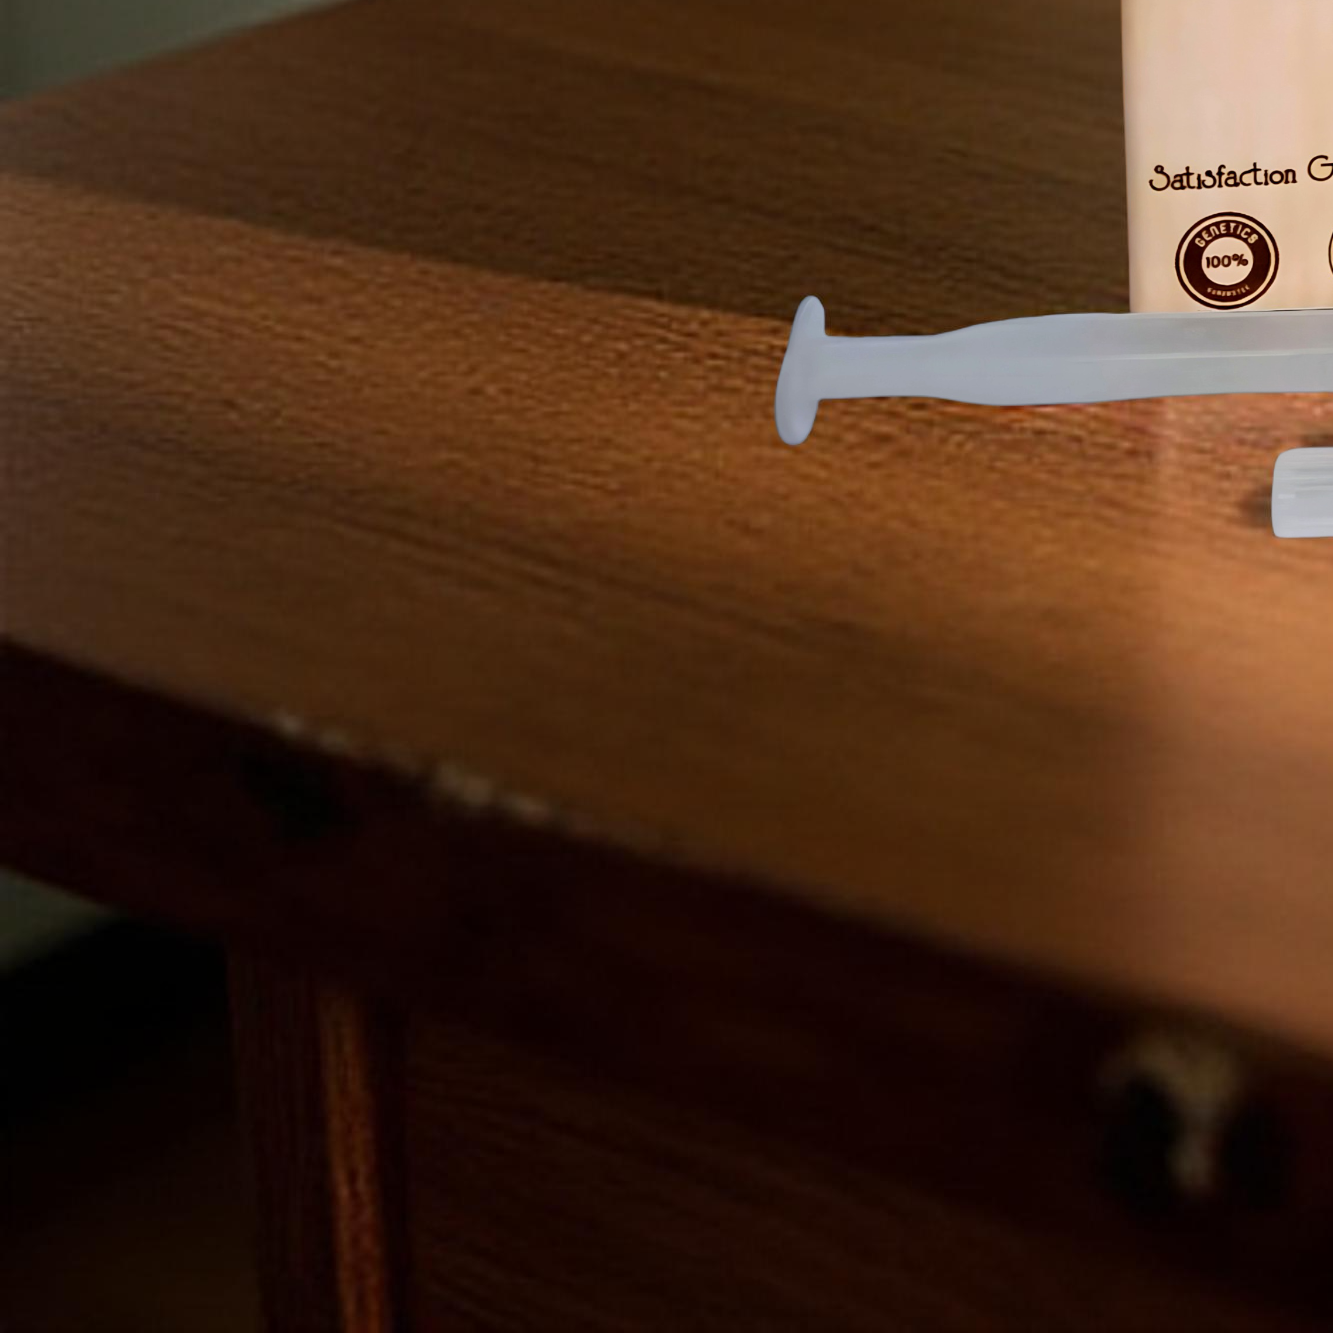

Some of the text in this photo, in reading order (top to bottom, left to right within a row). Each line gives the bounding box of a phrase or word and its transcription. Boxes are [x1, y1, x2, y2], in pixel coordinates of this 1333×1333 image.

[1148, 161, 1298, 192] Satisfaction
[1195, 222, 1259, 248] GENETICS
[1205, 253, 1249, 269] 100%
